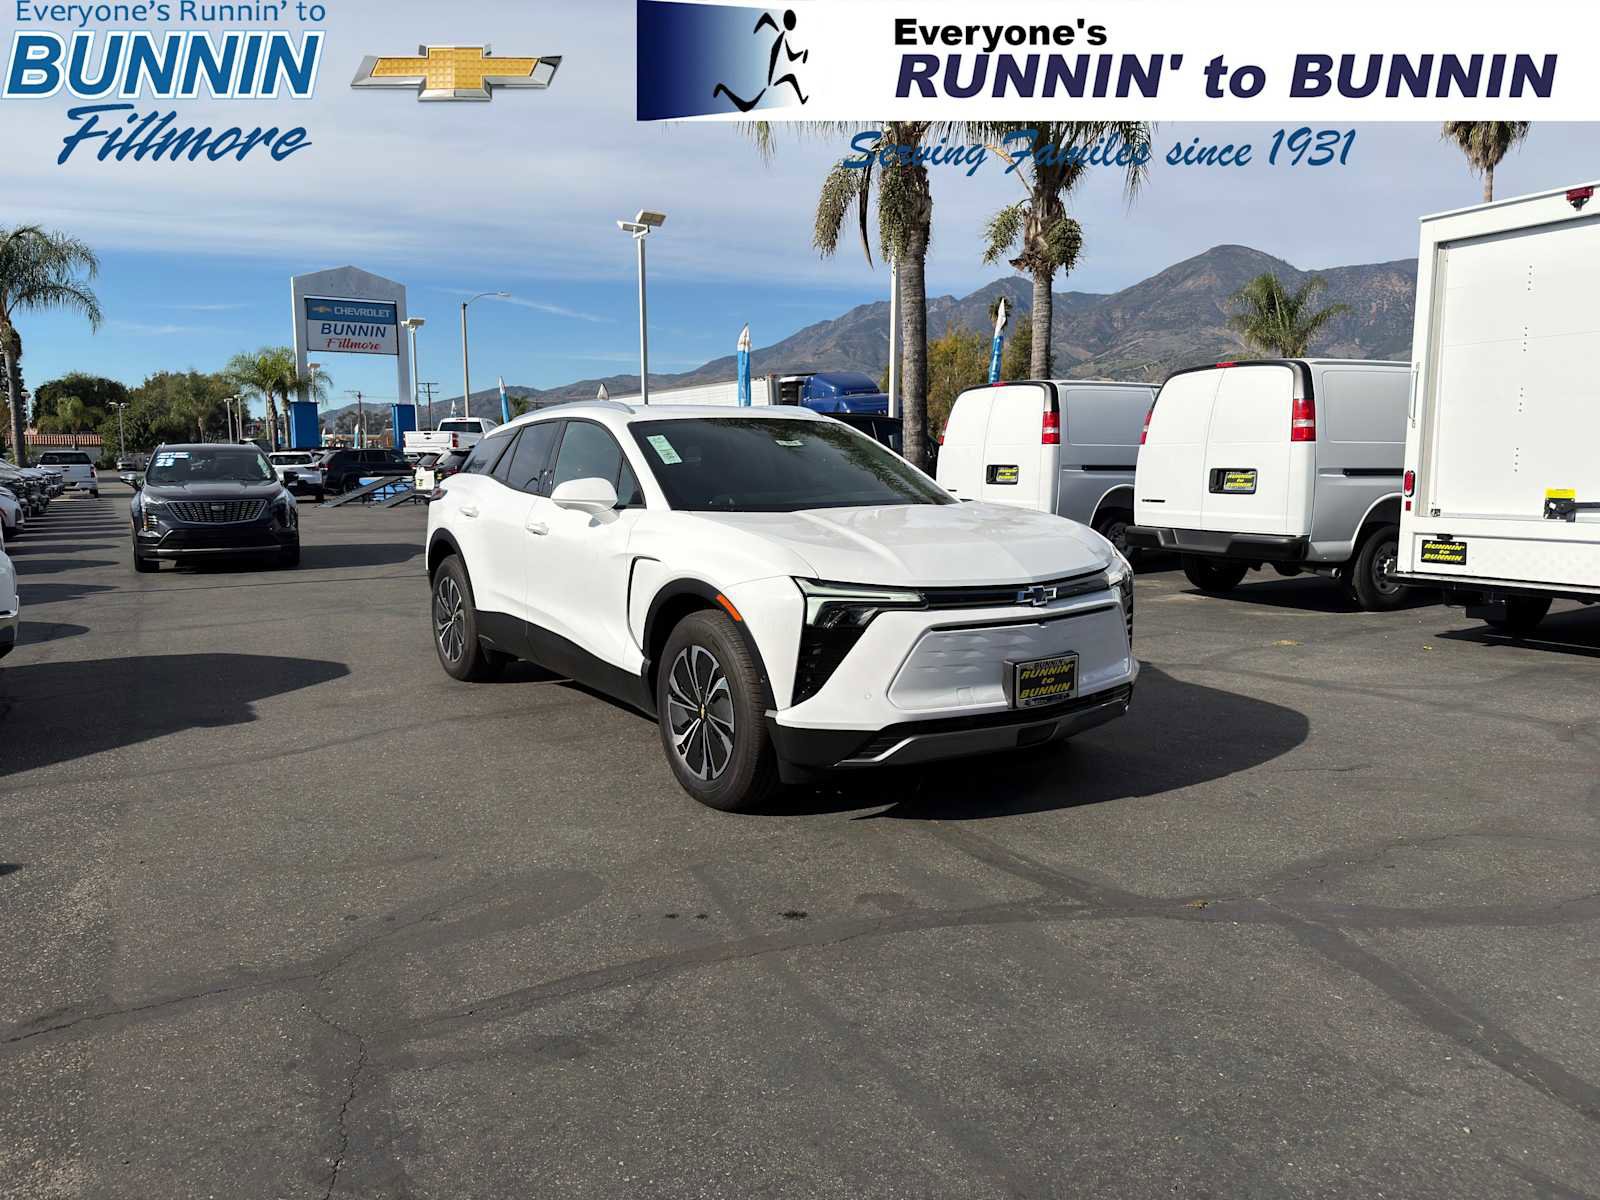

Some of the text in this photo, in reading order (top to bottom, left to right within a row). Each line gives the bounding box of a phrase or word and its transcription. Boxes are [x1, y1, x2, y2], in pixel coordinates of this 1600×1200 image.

[334, 306, 391, 318] CHEVROLET
[320, 322, 387, 338] BUNNIN
[326, 338, 382, 350] Fillmore
[1021, 664, 1074, 679] RUNNIN'
[1020, 682, 1071, 698] BUNNIN
